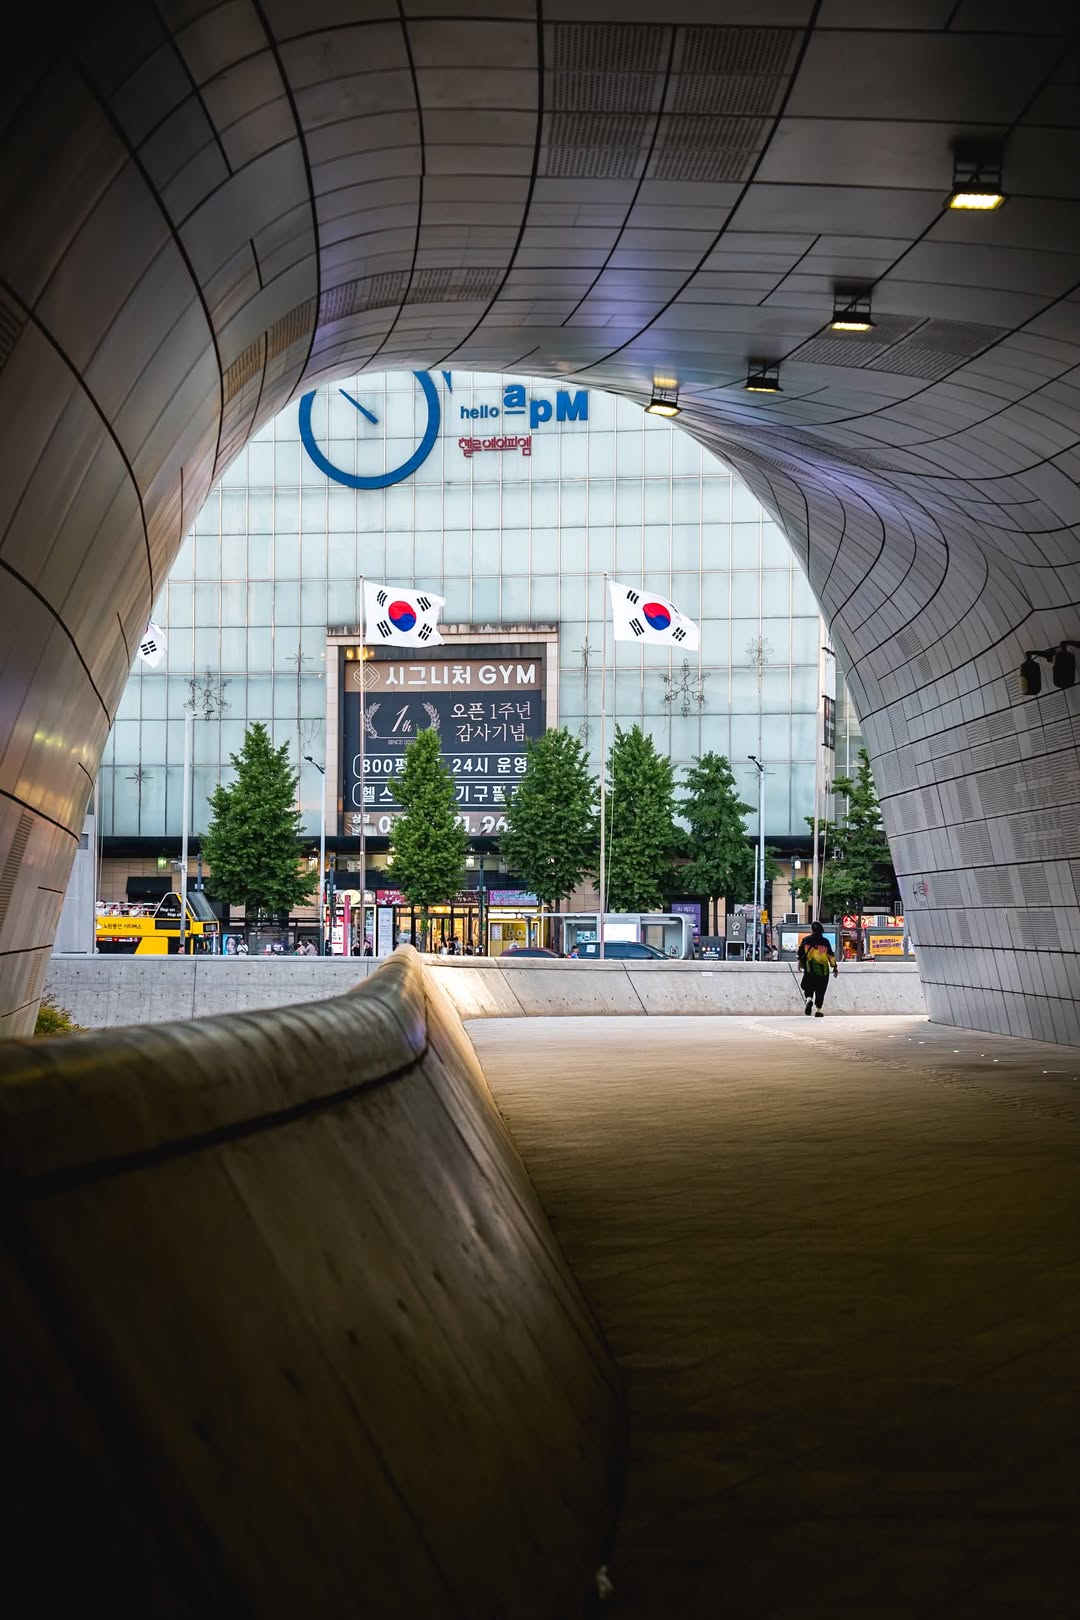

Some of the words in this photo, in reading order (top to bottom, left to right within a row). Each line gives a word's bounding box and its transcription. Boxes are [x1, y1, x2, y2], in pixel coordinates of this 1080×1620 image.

[460, 405, 499, 419] hello
[502, 384, 589, 428] apM
[458, 435, 532, 458] 헬로에이피엠
[385, 665, 471, 685] 시그니처
[478, 664, 536, 684] GYM
[450, 703, 485, 720] 오픈
[490, 701, 531, 720] 1주년
[456, 723, 525, 743] 감사기념
[452, 757, 488, 773] 24시
